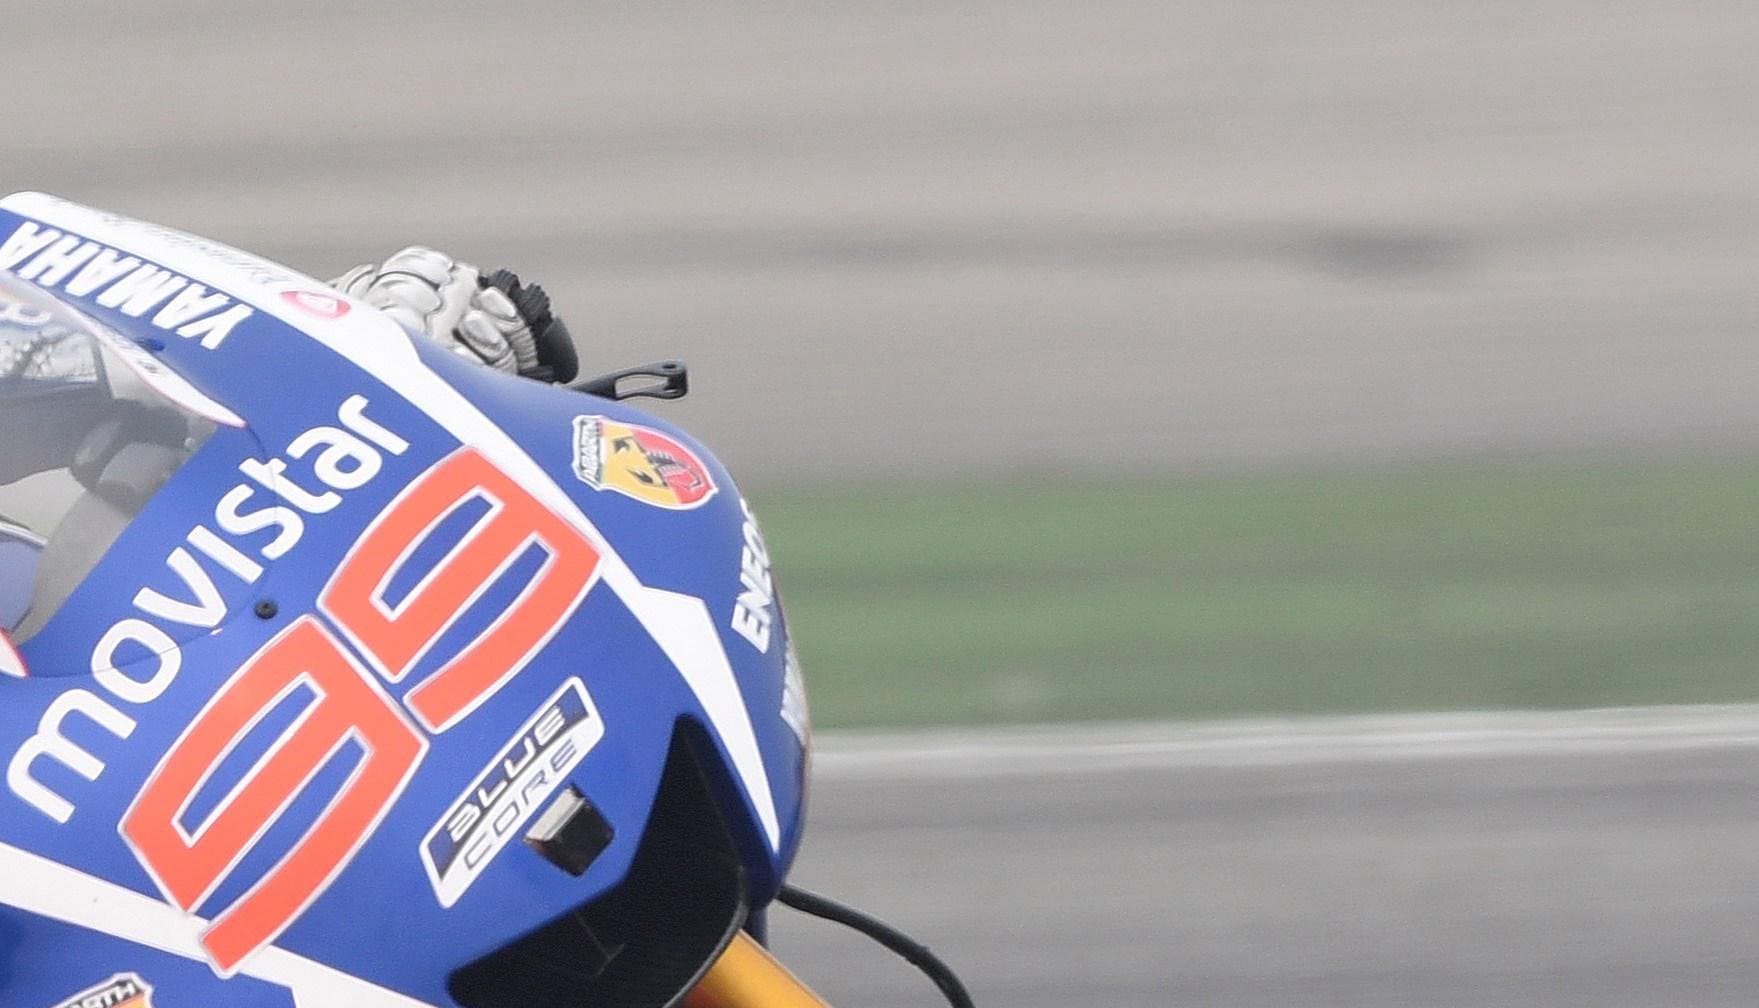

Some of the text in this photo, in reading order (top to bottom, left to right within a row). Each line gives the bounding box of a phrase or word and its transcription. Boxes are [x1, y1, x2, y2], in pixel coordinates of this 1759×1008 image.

[5, 393, 410, 824] movistar
[117, 444, 604, 979] 99
[445, 703, 567, 842] BLUE
[463, 741, 577, 870] CORE
